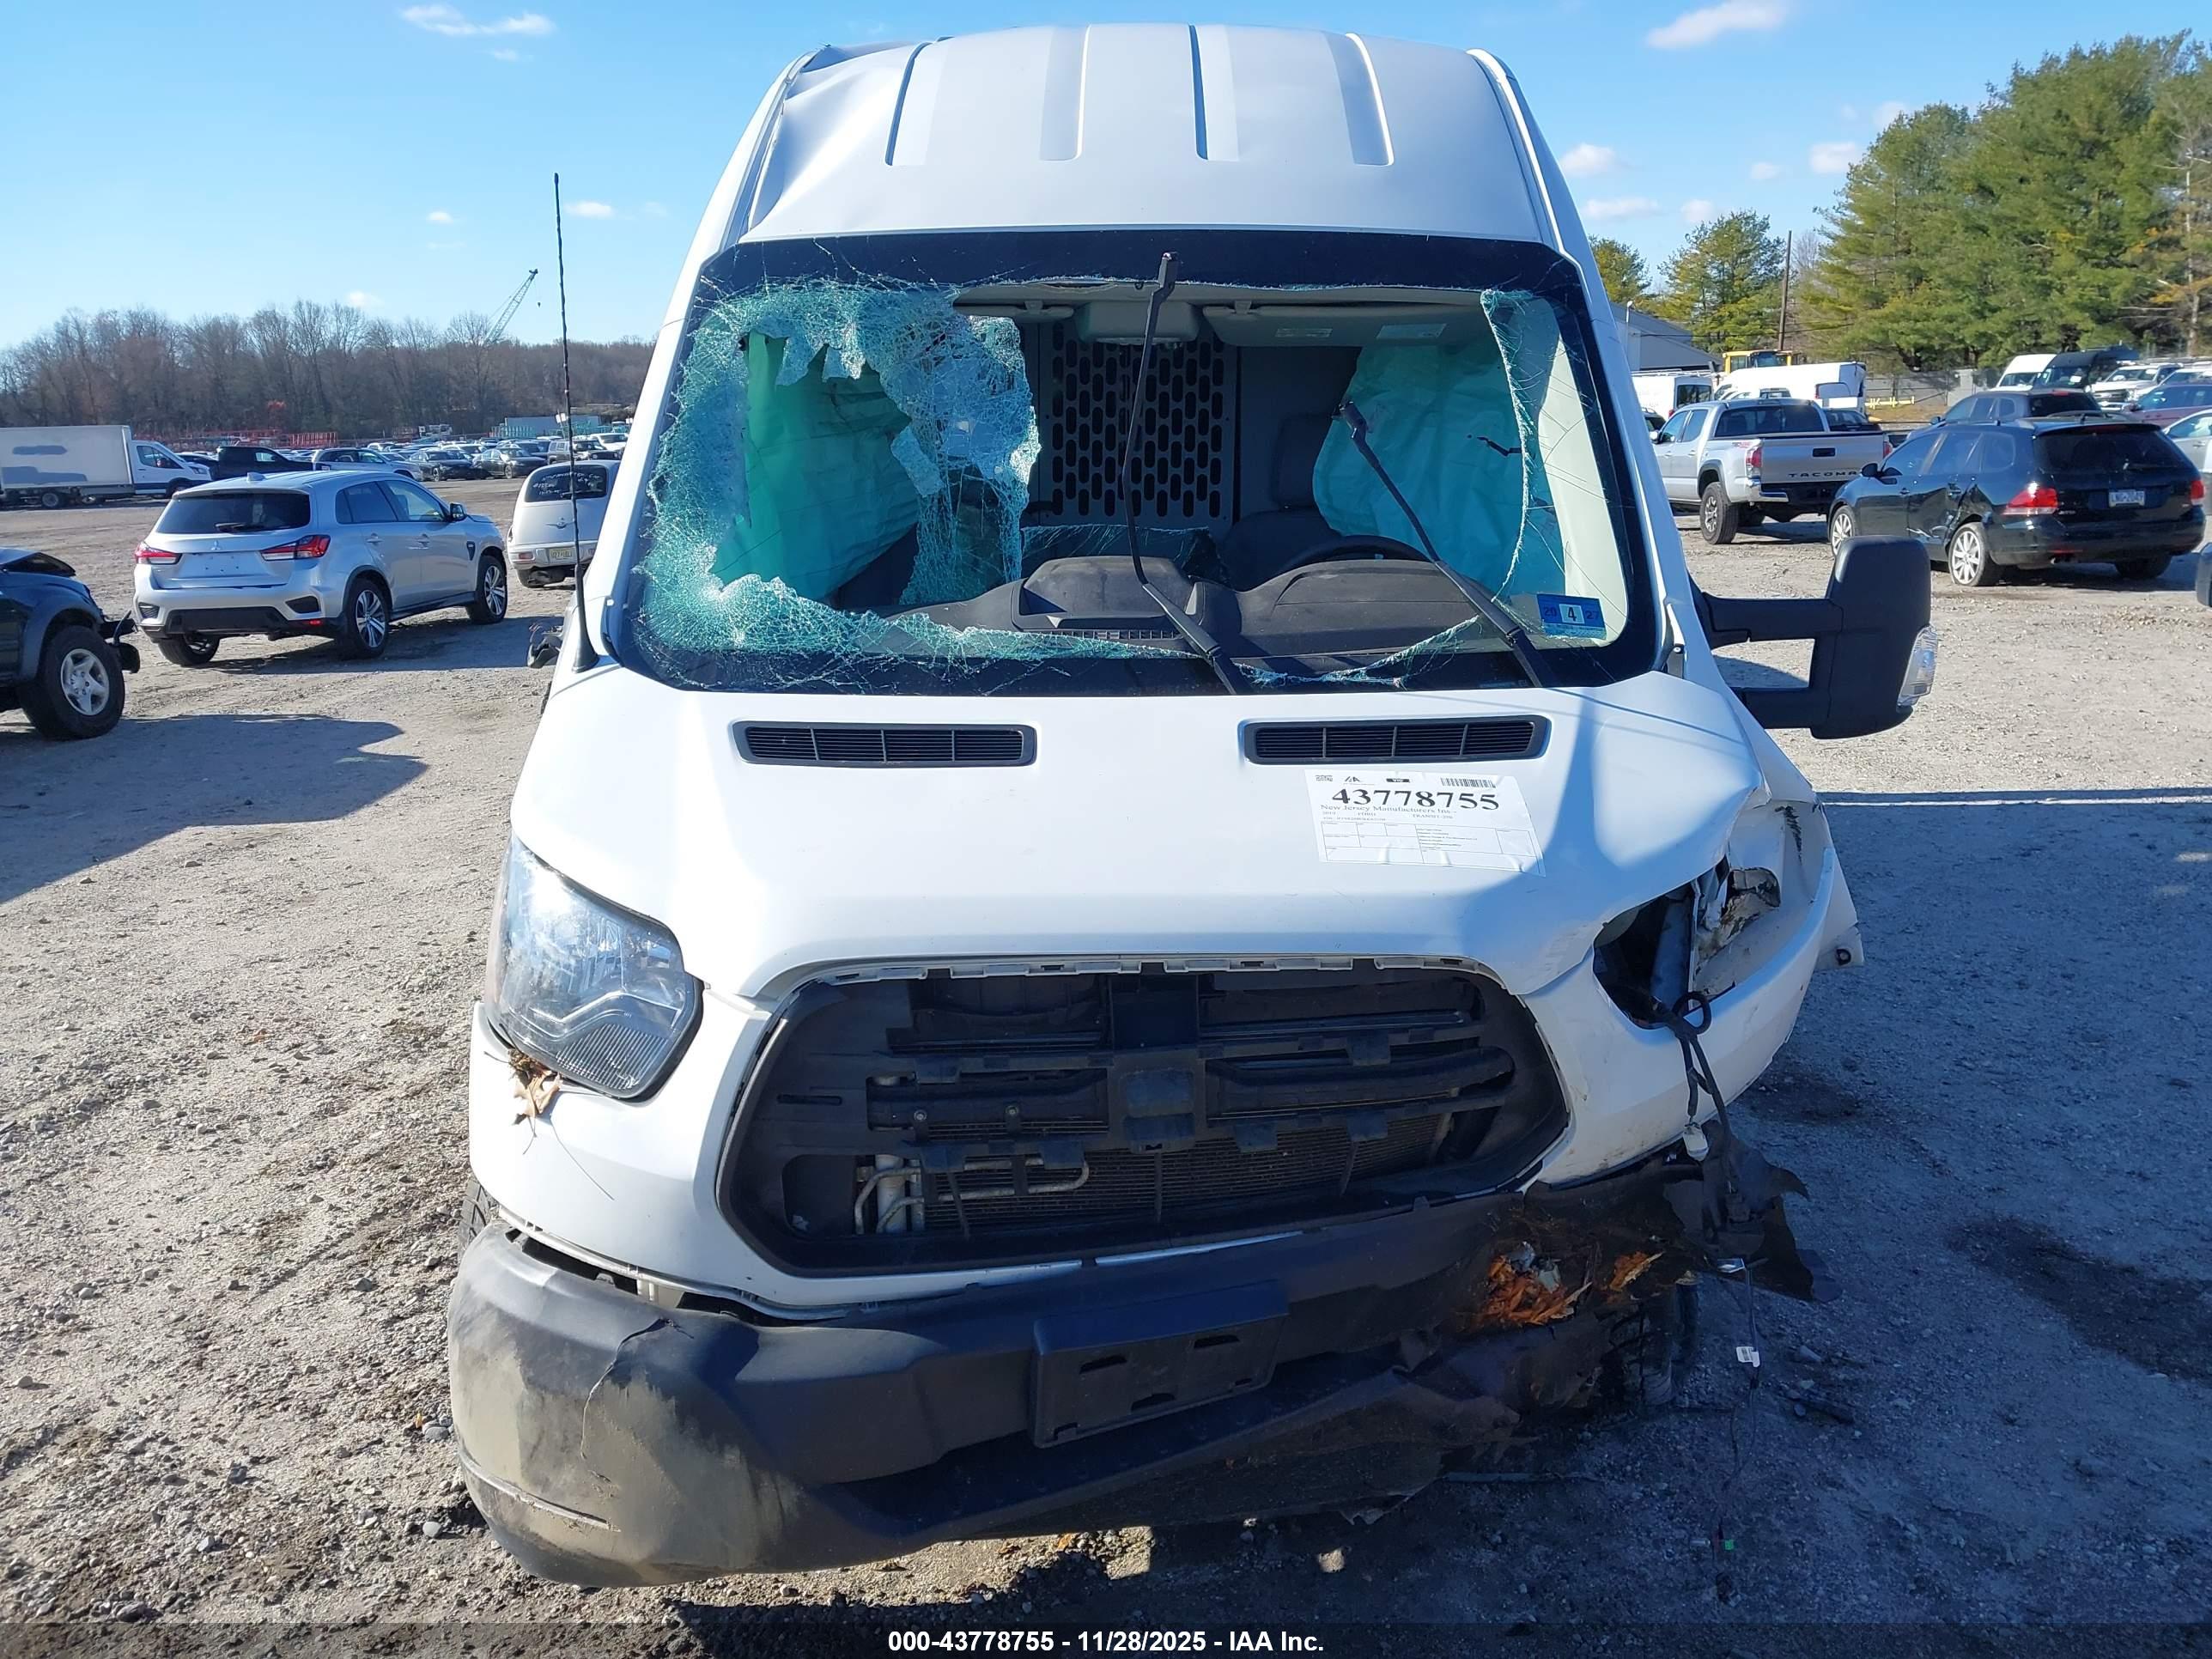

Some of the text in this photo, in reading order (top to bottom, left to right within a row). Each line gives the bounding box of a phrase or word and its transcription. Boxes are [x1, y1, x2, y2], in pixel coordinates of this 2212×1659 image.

[1543, 607, 1599, 622] 20 4 27
[1332, 788, 1499, 811] 43778755
